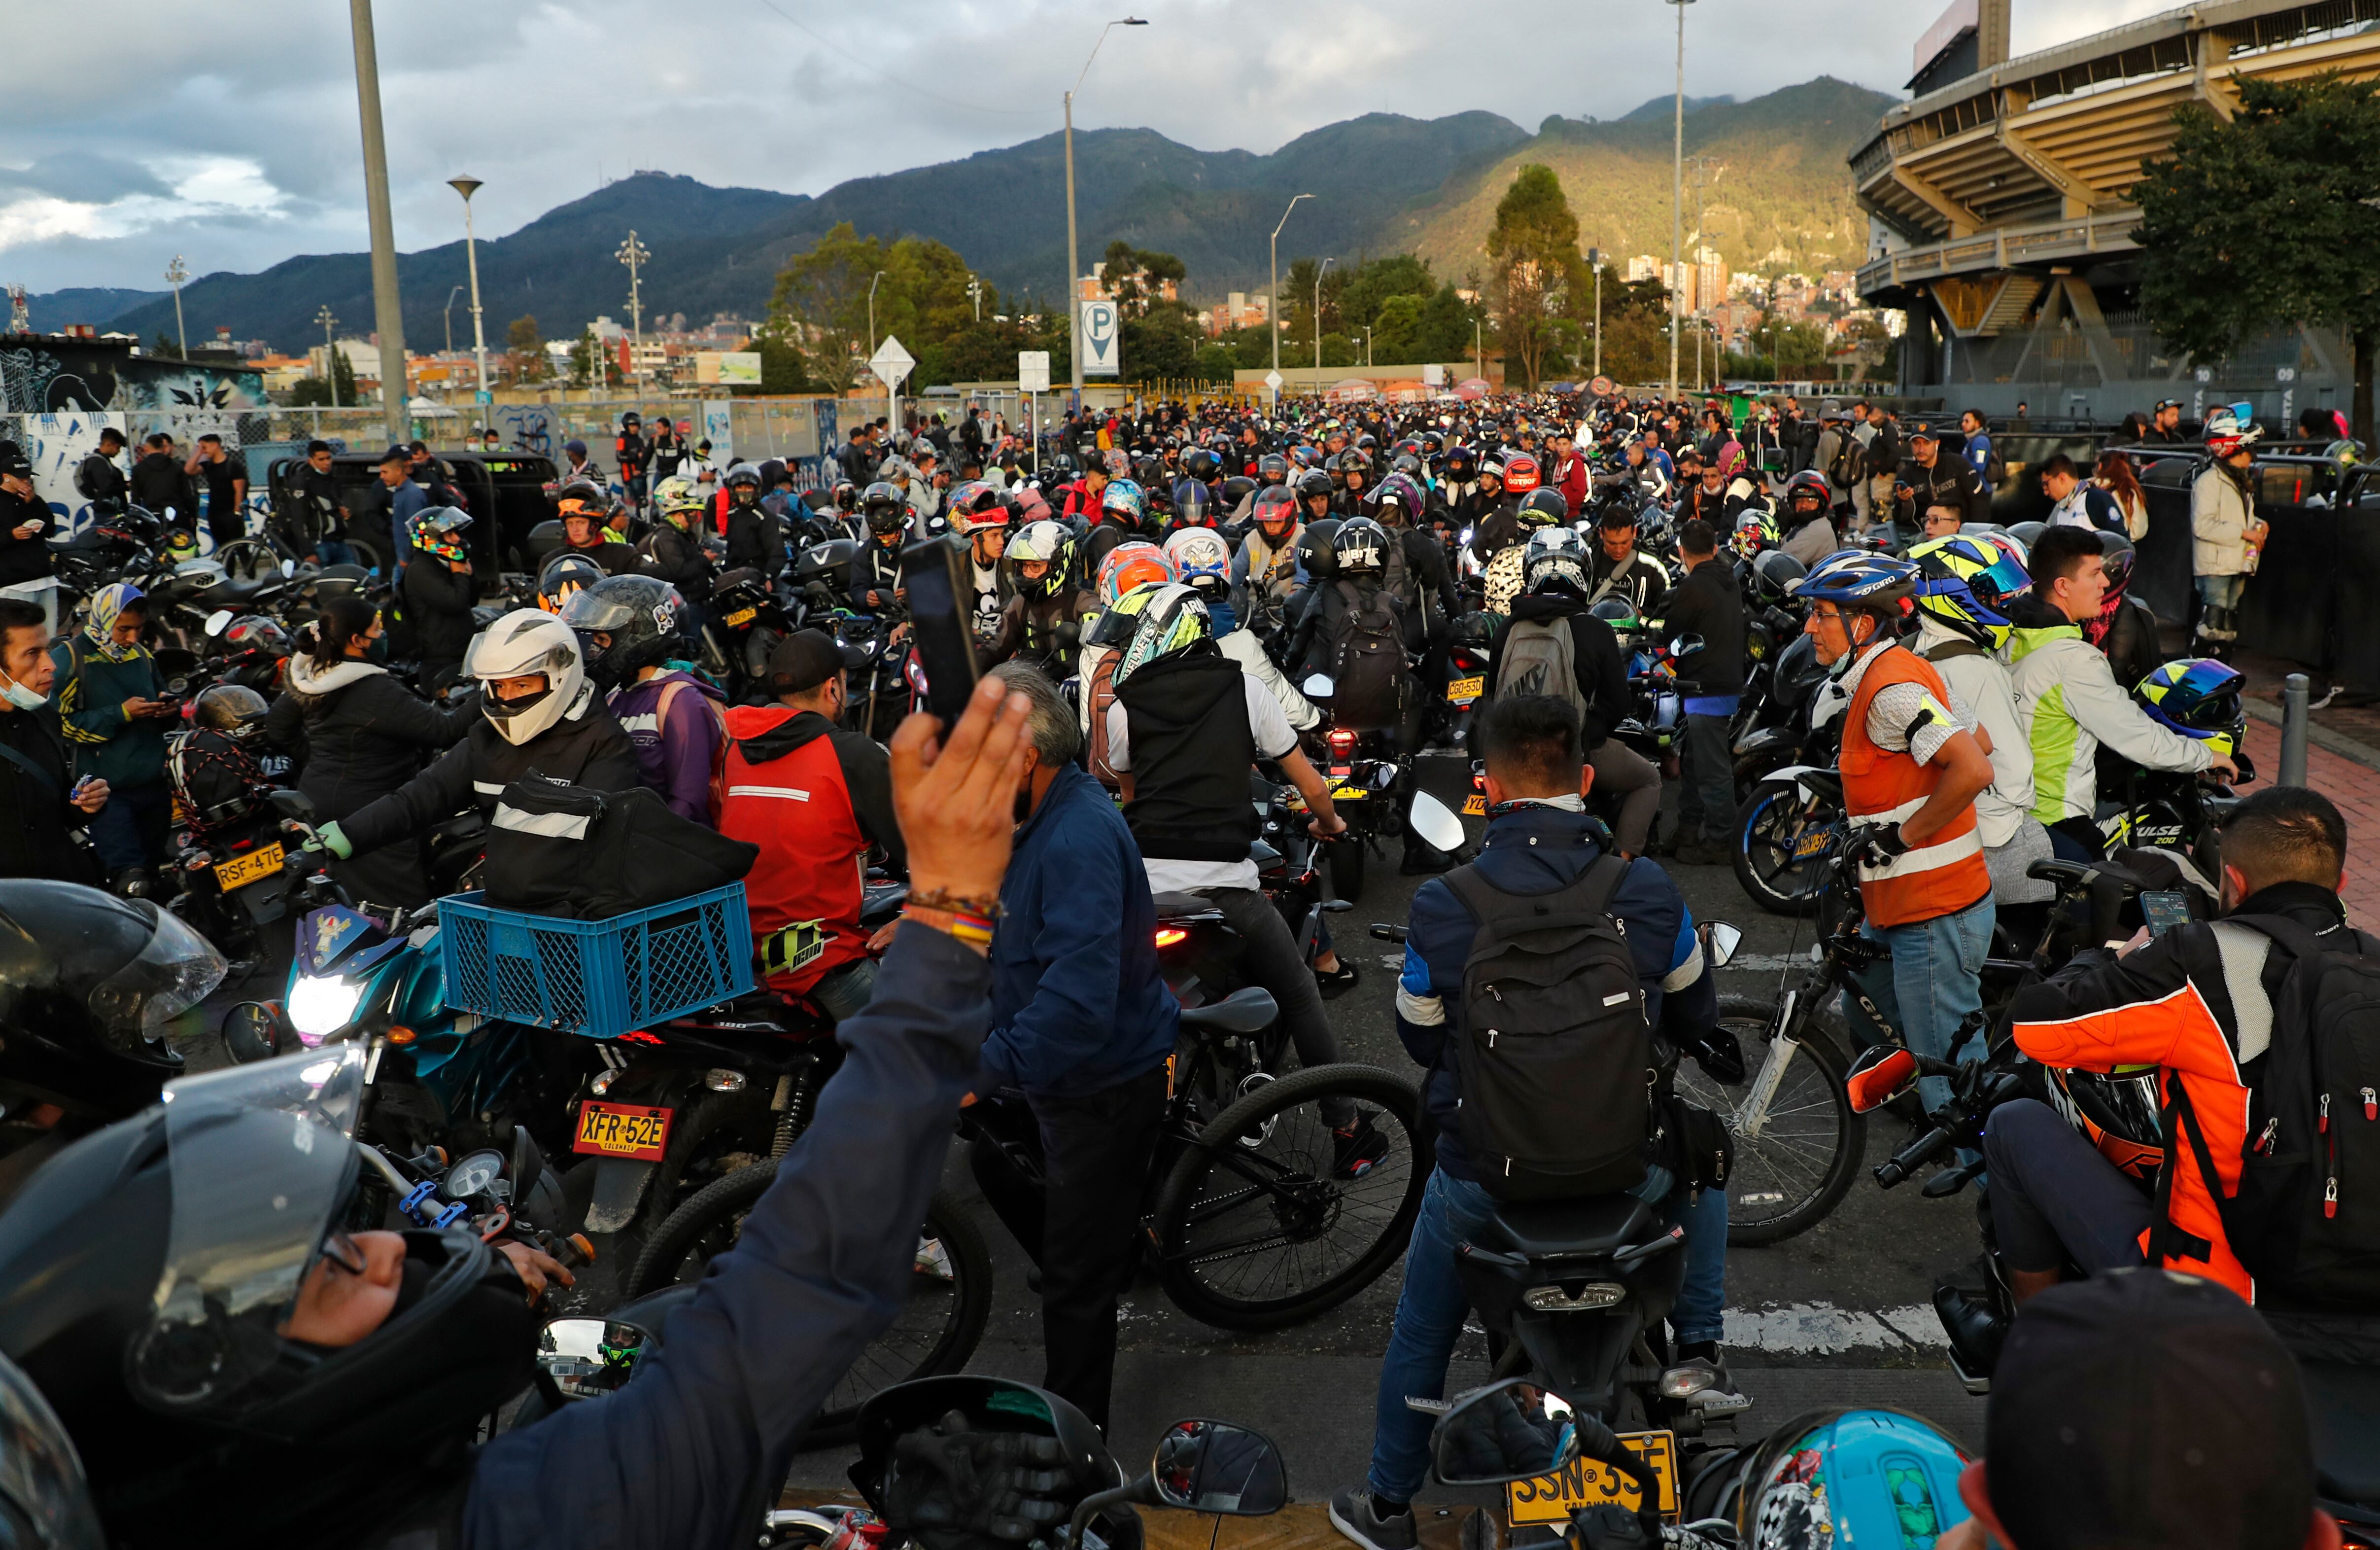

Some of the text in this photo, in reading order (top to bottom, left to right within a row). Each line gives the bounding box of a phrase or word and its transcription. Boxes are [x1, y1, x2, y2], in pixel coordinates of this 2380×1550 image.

[1094, 309, 1110, 336] P
[2196, 369, 2210, 382] 10
[2277, 368, 2294, 381] 09
[1872, 575, 1896, 591] GIRO
[1469, 797, 1484, 810] YD
[218, 846, 283, 884] RSF 47E
[582, 1112, 664, 1147] XFR 52E
[604, 1143, 634, 1152] COLOMBIA
